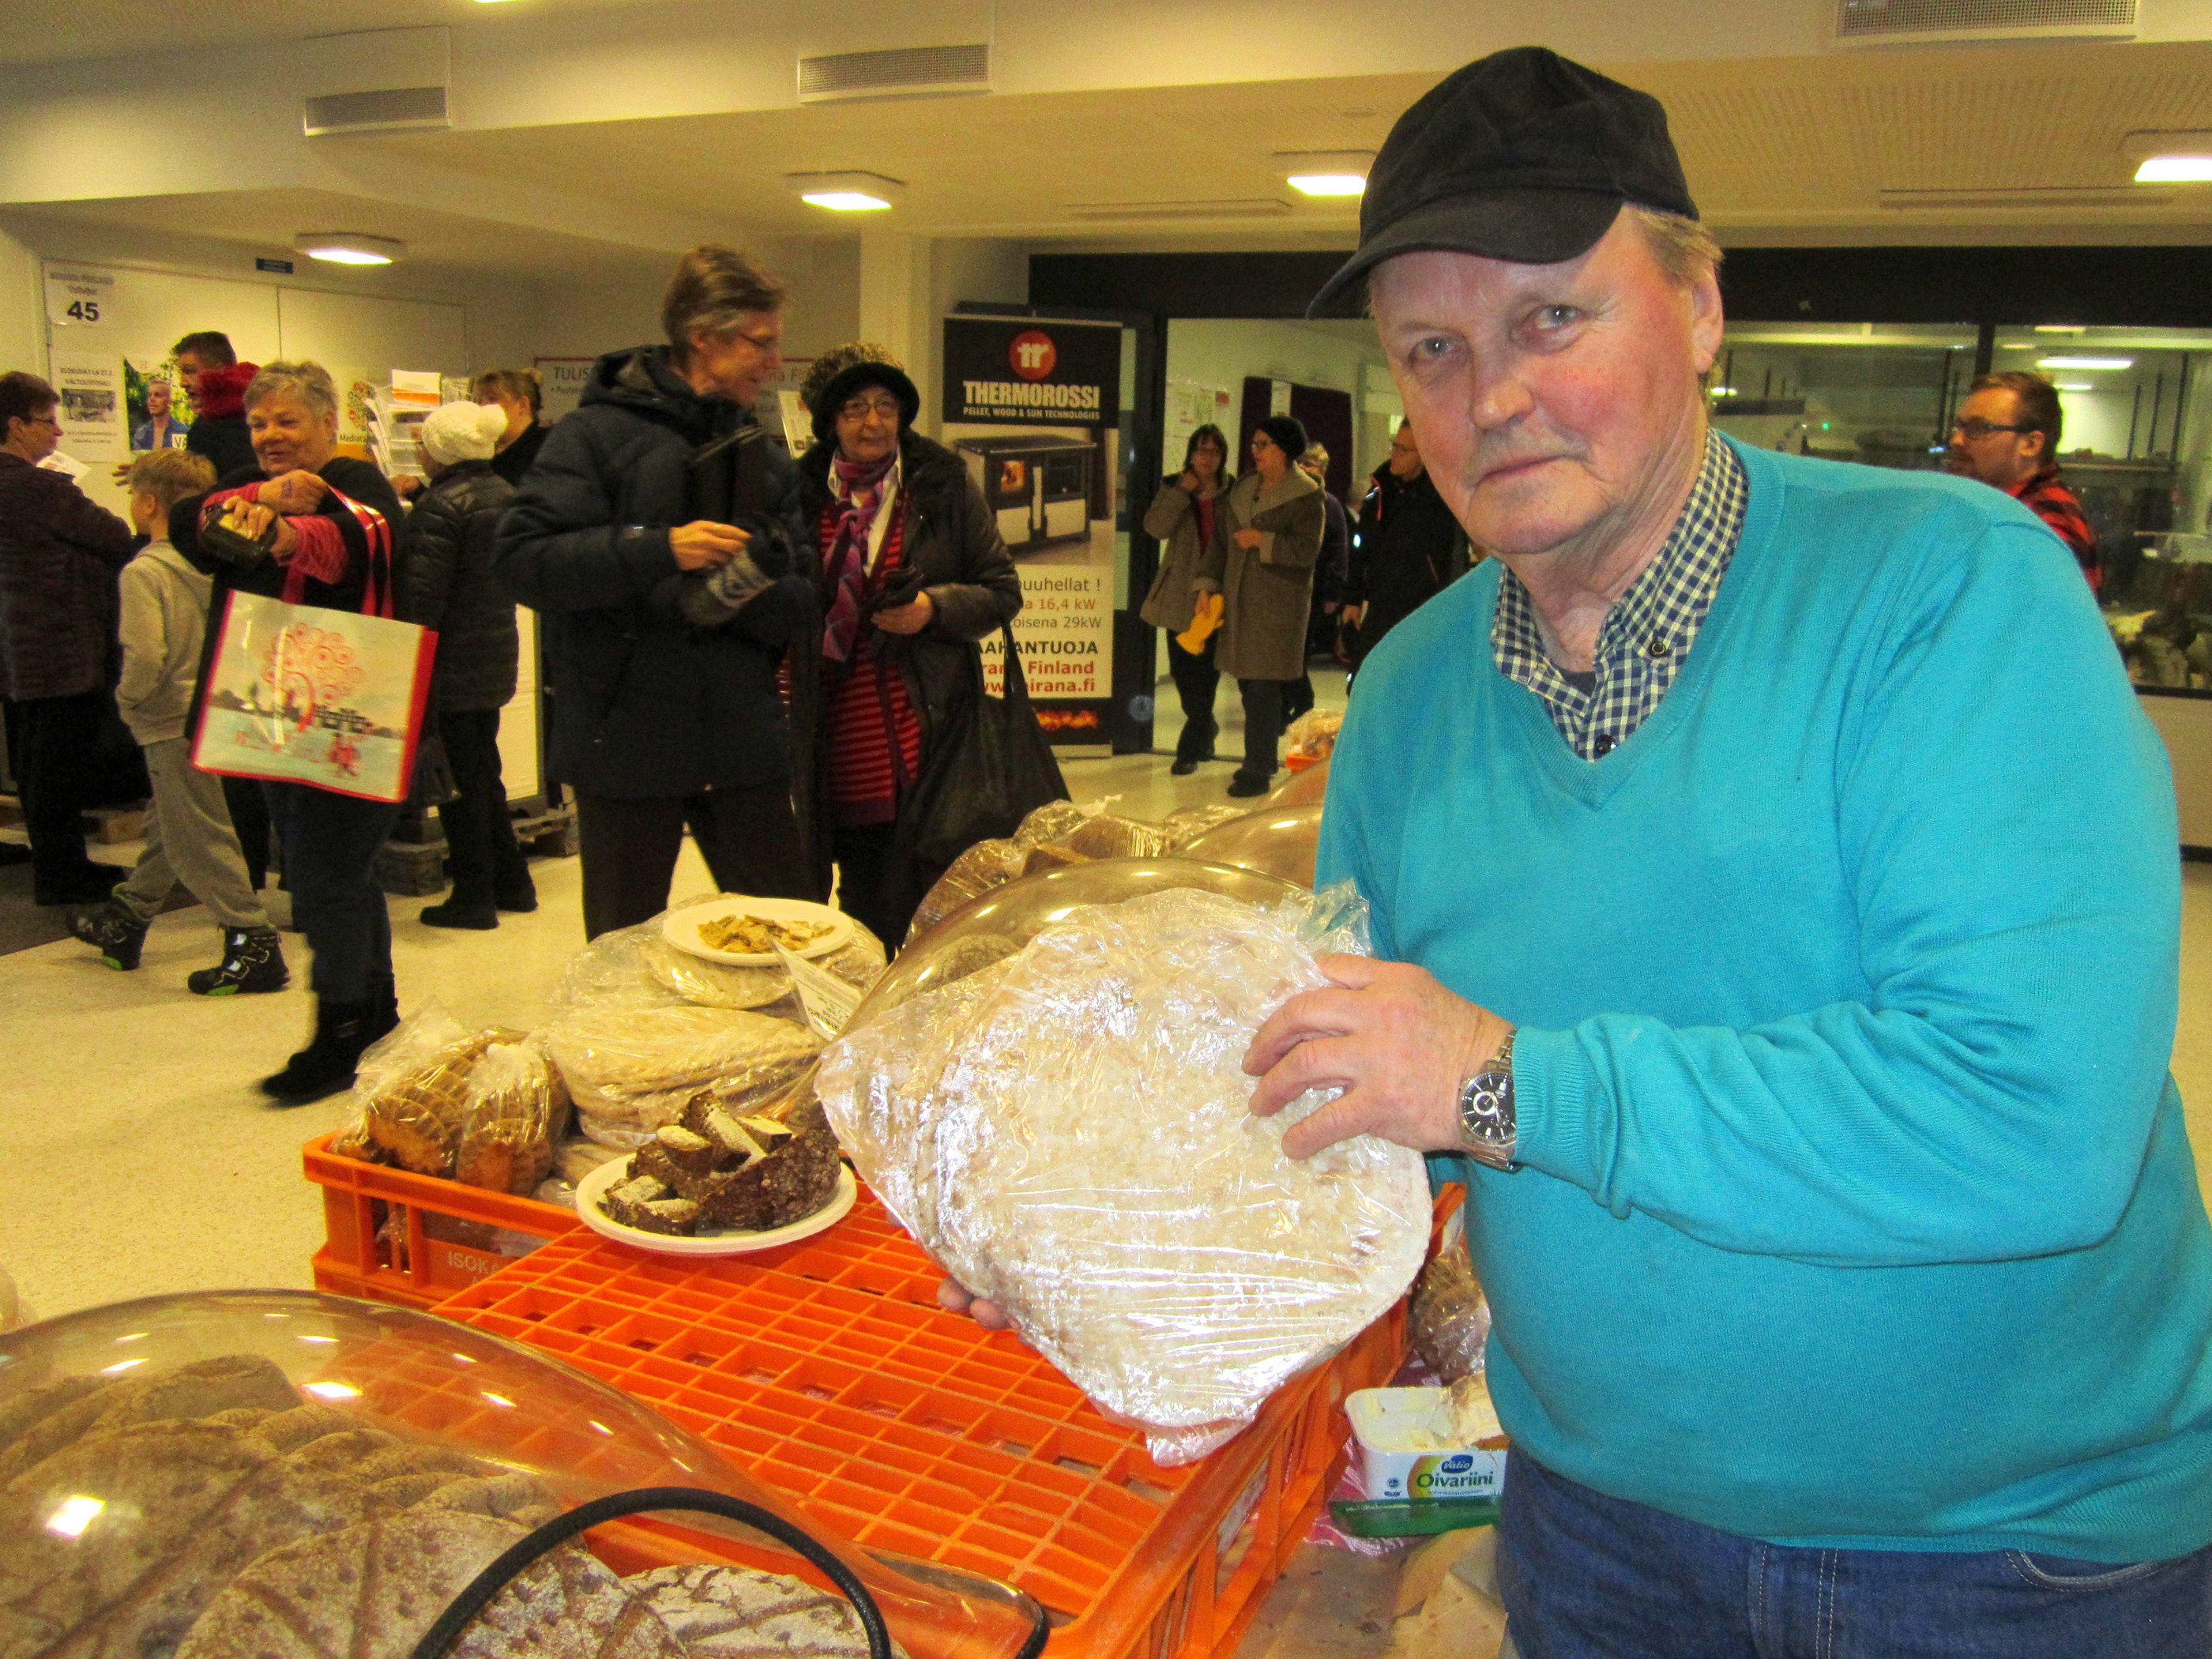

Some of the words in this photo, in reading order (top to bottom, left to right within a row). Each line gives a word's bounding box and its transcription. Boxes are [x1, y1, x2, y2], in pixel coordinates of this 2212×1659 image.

[67, 300, 100, 322] 45
[963, 381, 1100, 408] THERMOROSSI
[992, 408, 1017, 416] WOOD
[1045, 410, 1100, 419] TECHNOLOGIES
[1039, 598, 1069, 611] 16,4
[1074, 598, 1097, 609] kW
[1012, 618, 1057, 628] oisena
[1063, 616, 1101, 628] 29kW
[1028, 660, 1095, 675] Finland
[1444, 1459, 1470, 1469] Valio
[1416, 1471, 1494, 1488] Oivariini
